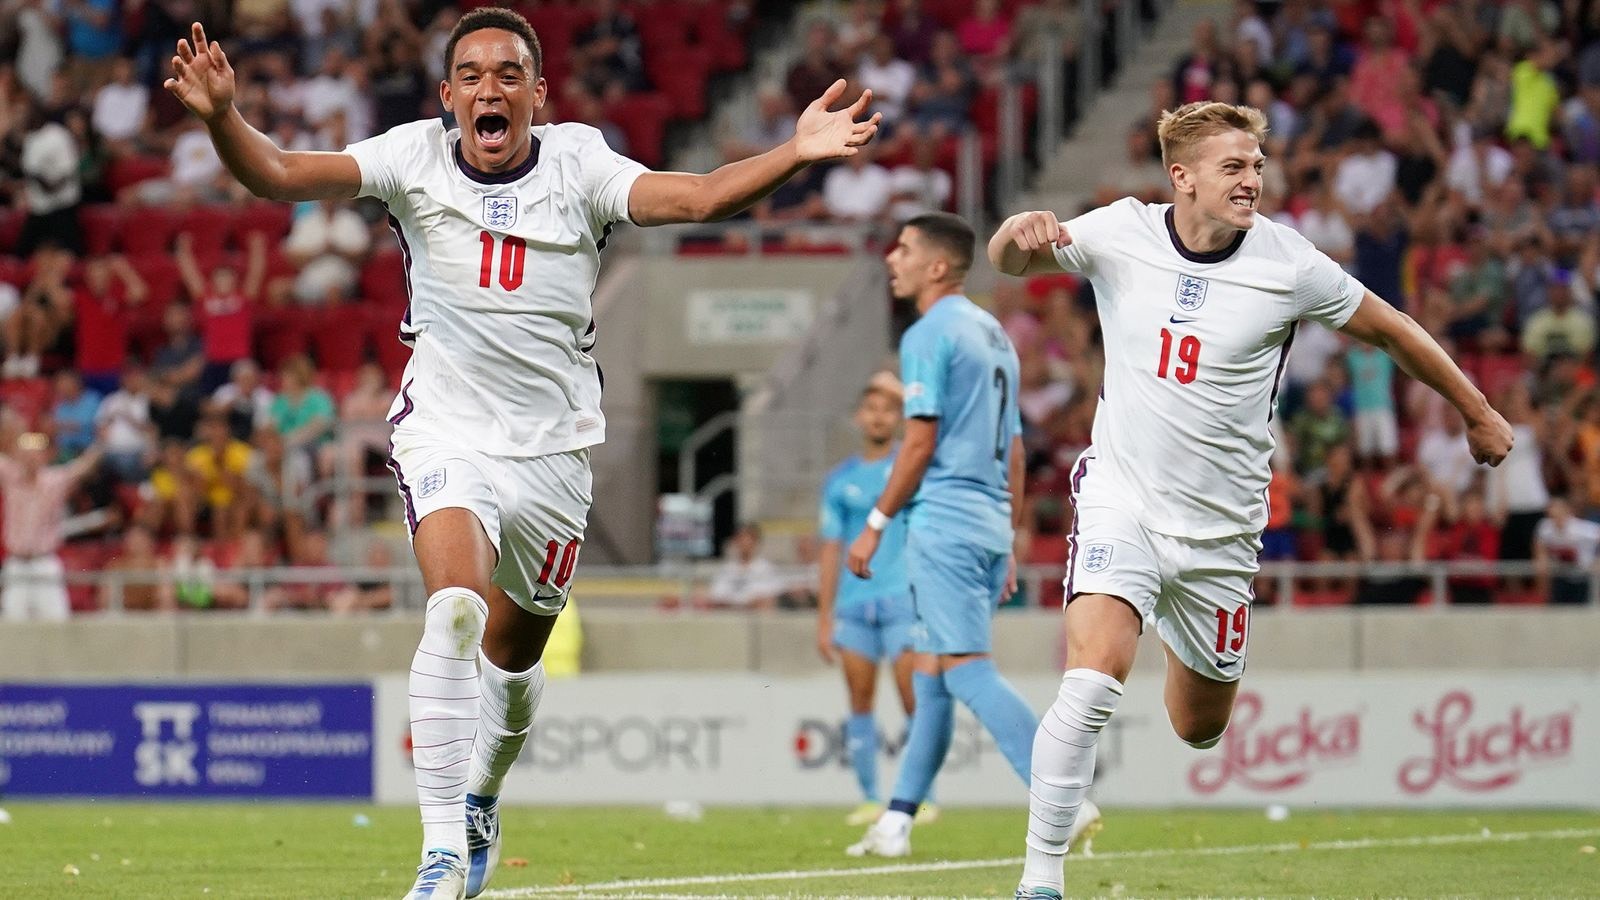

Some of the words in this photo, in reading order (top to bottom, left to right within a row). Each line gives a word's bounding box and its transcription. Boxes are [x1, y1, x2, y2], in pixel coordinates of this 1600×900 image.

[479, 231, 527, 292] 10
[1157, 328, 1202, 385] 19
[993, 365, 1009, 462] 2
[536, 537, 580, 588] 10
[1214, 603, 1247, 654] 19
[134, 741, 199, 787] SK
[1187, 690, 1361, 794] Lucka
[1396, 690, 1574, 794] Lucka
